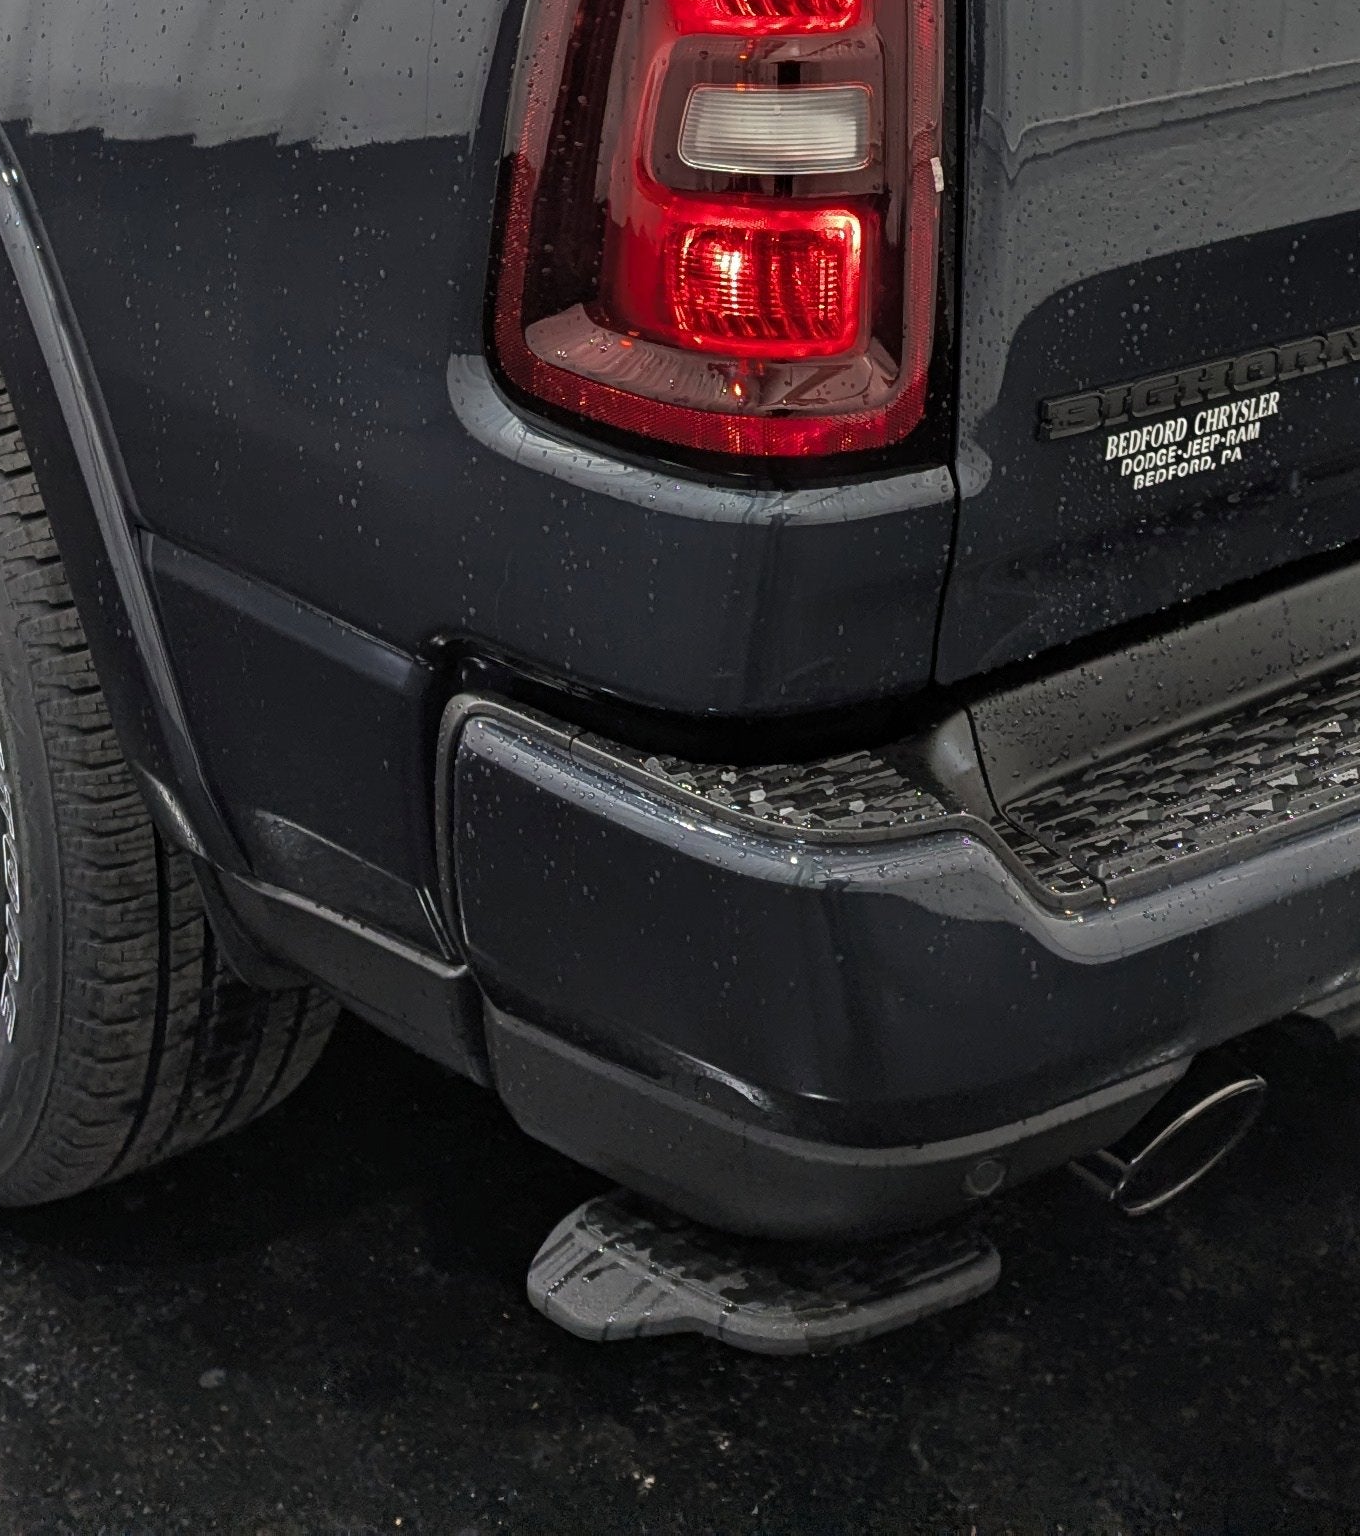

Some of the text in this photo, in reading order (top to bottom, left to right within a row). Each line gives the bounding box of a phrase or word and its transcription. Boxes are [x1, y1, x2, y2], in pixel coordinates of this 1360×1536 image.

[1104, 391, 1281, 462] BEDFORD CHRYSLER
[1133, 446, 1243, 491] BEDFORD, PA
